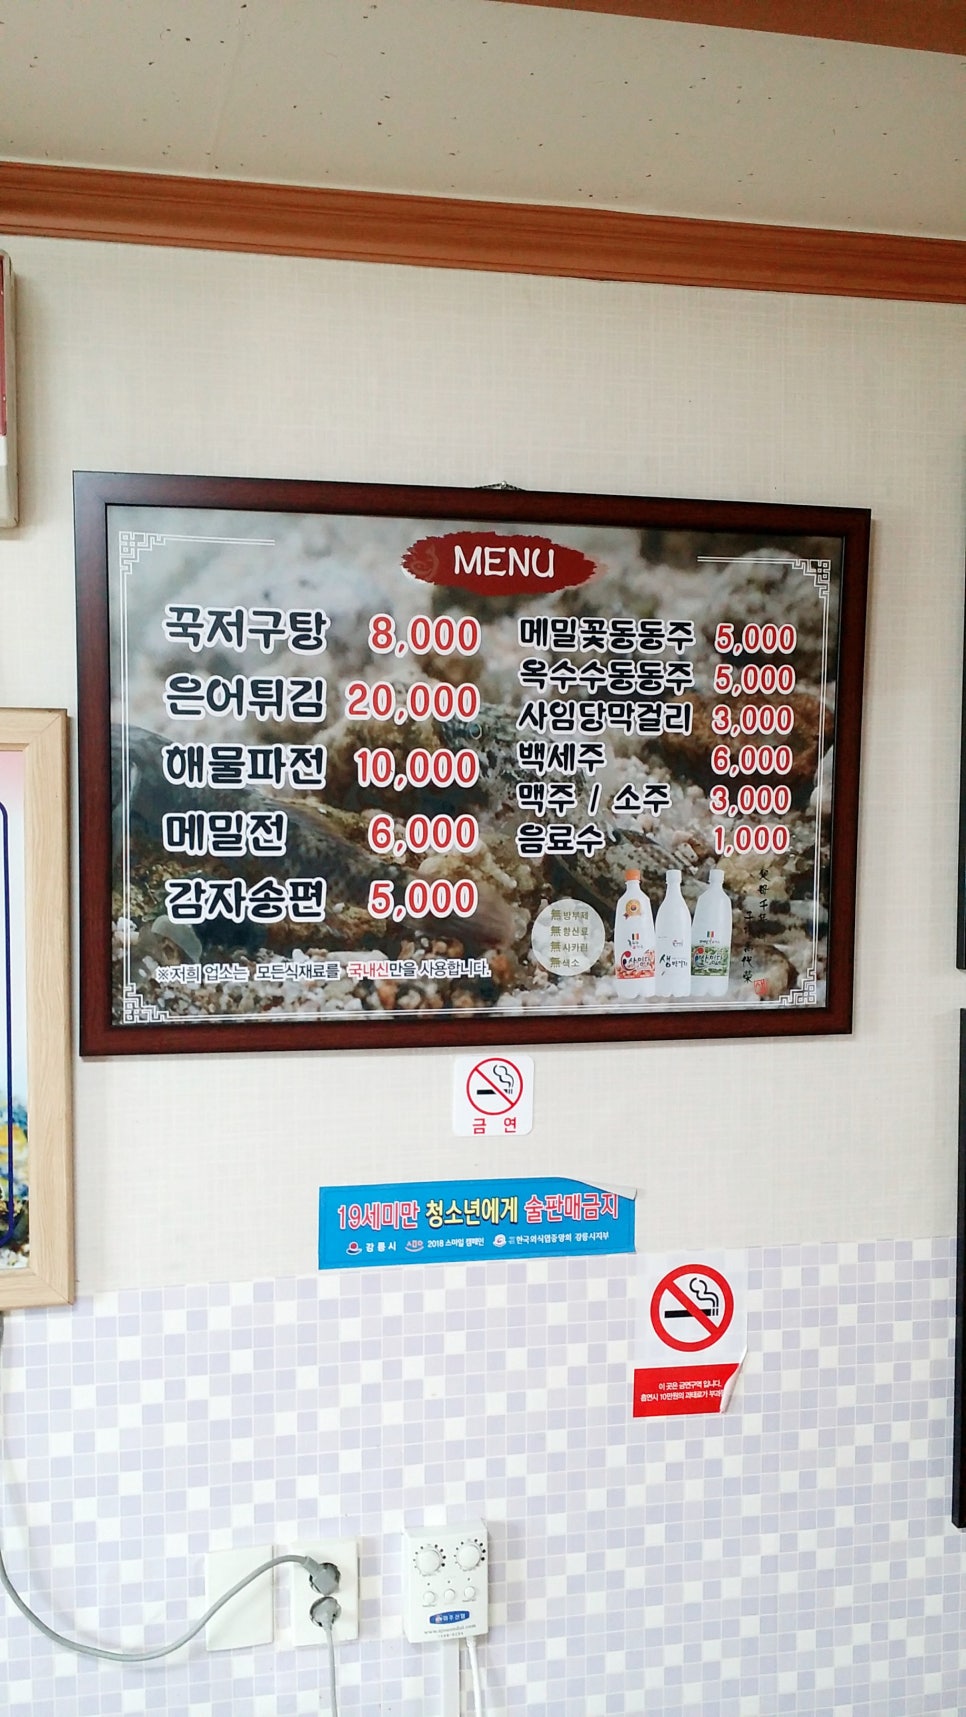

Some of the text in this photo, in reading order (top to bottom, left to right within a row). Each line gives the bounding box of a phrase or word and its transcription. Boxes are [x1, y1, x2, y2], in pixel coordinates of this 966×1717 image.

[453, 544, 556, 579] MENU
[163, 605, 330, 654] 꾹저구탕
[368, 613, 482, 658] 8,000
[517, 617, 697, 655] 메밀꽃동동주
[713, 622, 798, 657] 5,000
[517, 657, 695, 695] 옥수수동동주
[712, 663, 796, 698] 5,000
[163, 672, 328, 722] 은어튀김
[344, 680, 482, 725] 20,000
[515, 699, 695, 736] 사임당막걸리
[711, 704, 795, 738] 3,000
[160, 743, 328, 789] 해물파전
[353, 746, 481, 792] 10,000
[516, 741, 606, 776] 백세주
[710, 745, 794, 778] 6,000
[516, 782, 672, 817] 맥주 / 소주
[709, 785, 792, 817] 3,000
[162, 810, 288, 857] 메밀전
[367, 813, 480, 855] 6,000
[516, 823, 606, 857] 음료수
[712, 824, 790, 857] 1,000
[163, 877, 328, 924] 감자송편
[367, 879, 480, 922] 5,000
[204, 964, 248, 981] 업소는
[256, 962, 340, 981] 모든식재료를
[419, 959, 491, 978] 사용합니다.
[472, 1116, 517, 1134] 금 연
[337, 1192, 619, 1230] 19세미만 청소년에게 술판매금지
[427, 1240, 445, 1248] 2018
